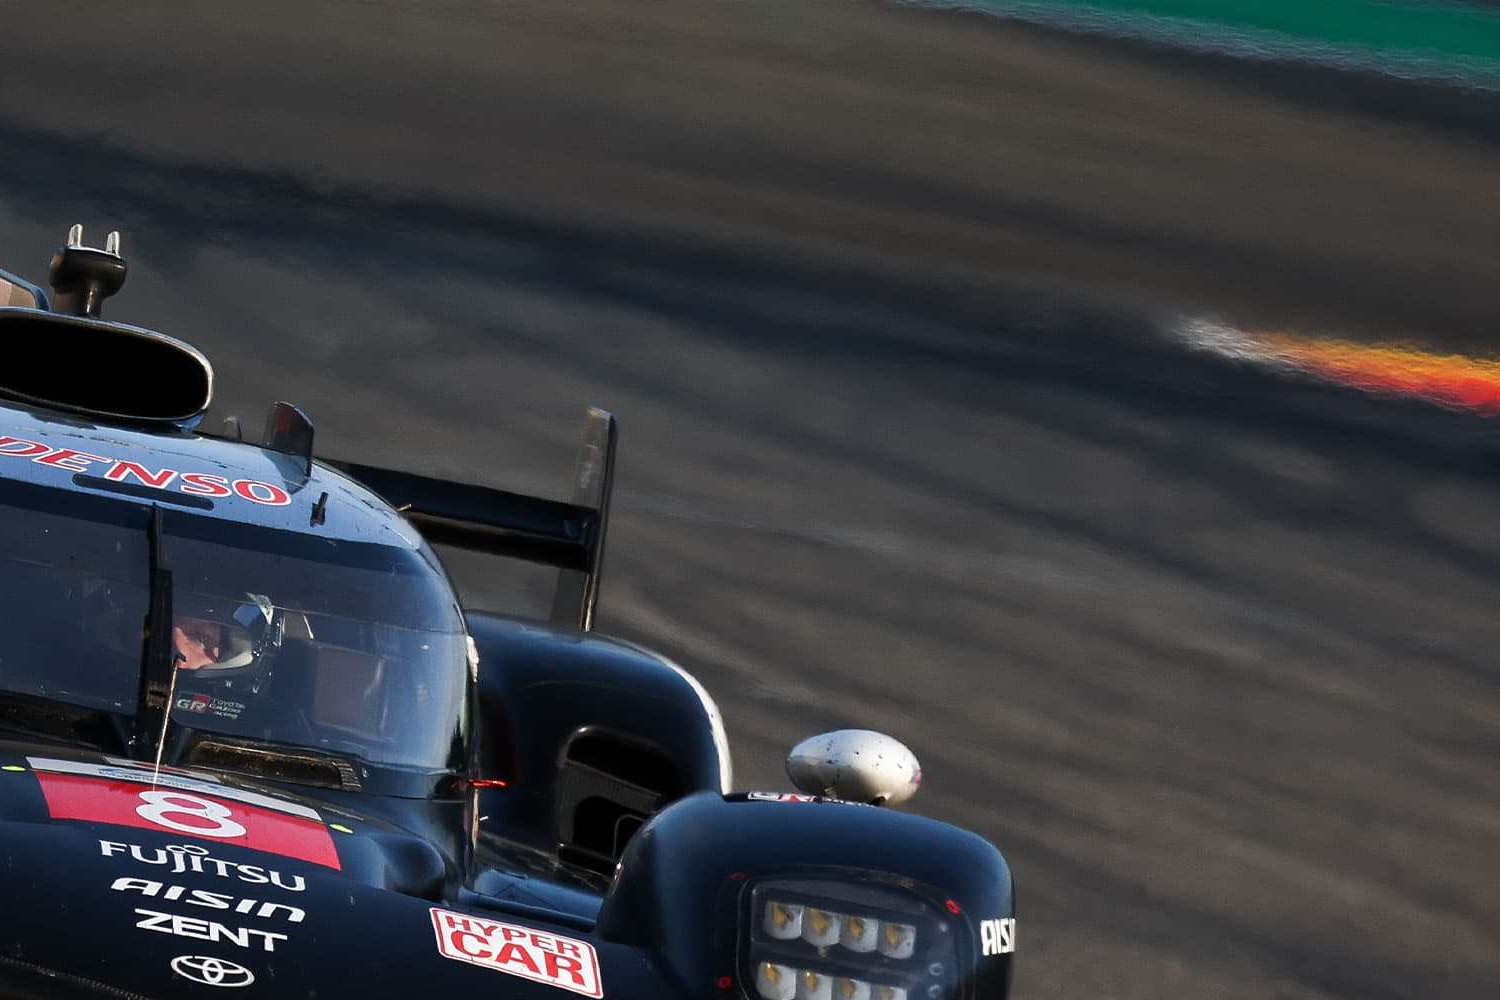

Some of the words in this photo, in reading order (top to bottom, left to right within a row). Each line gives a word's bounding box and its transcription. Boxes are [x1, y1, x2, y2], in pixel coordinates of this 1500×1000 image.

[177, 699, 206, 714] GR
[135, 790, 247, 838] 8
[99, 840, 306, 892] FUJITSU
[110, 876, 307, 923] AISIN
[134, 908, 288, 952] ZENT
[445, 915, 582, 958] HYPER
[450, 930, 586, 987] CAR
